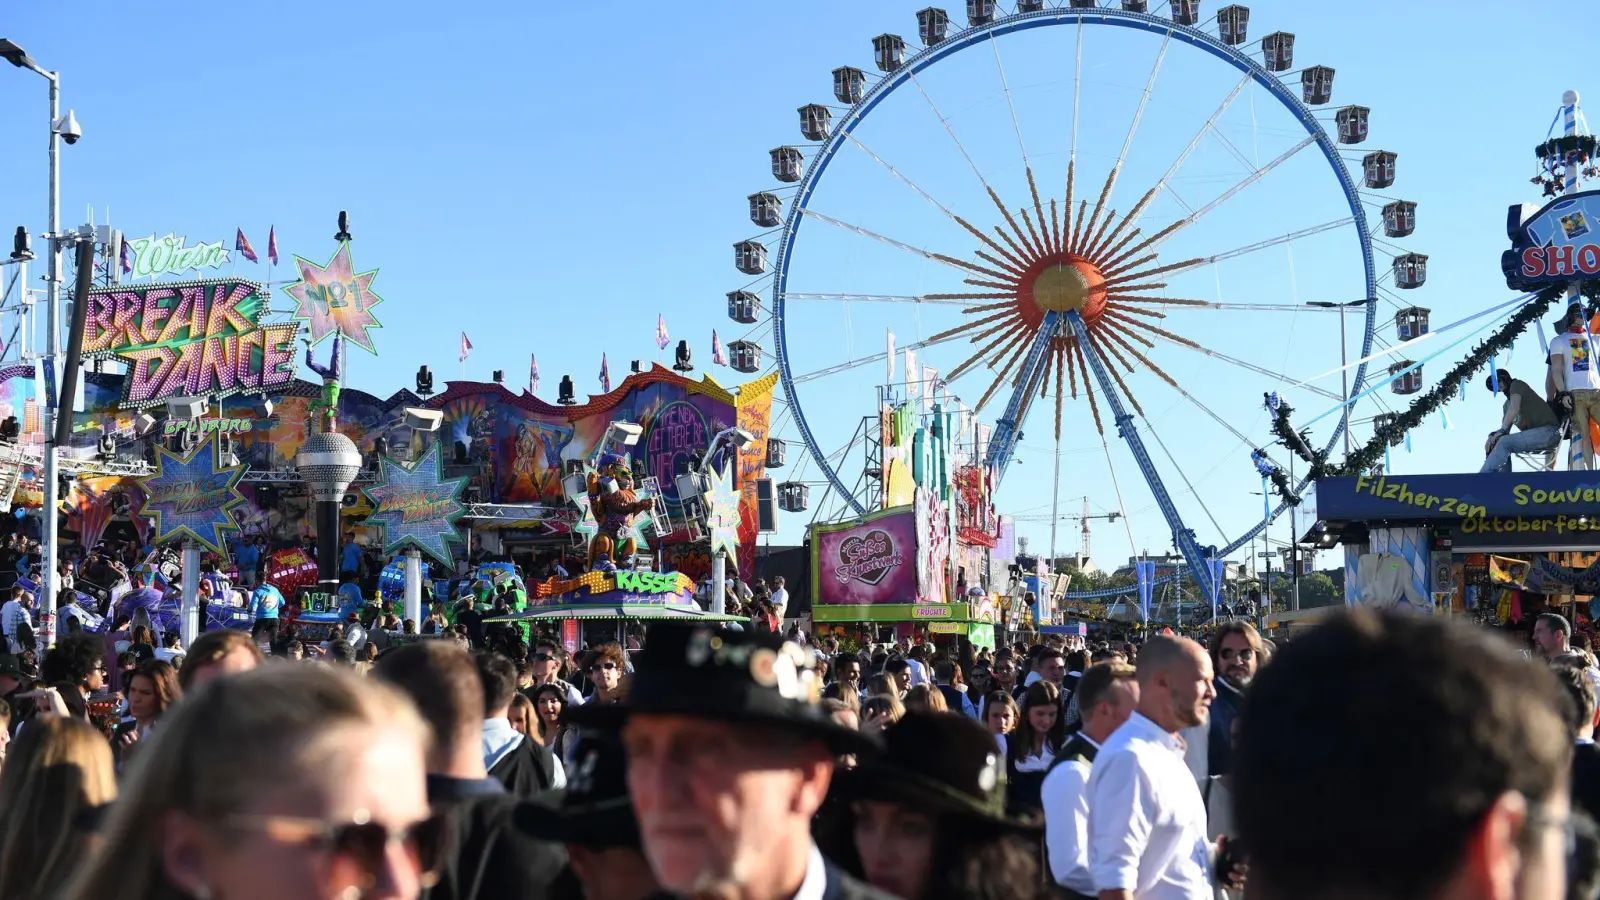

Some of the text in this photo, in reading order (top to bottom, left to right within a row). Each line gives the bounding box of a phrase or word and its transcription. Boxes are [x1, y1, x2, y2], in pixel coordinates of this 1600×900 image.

[134, 239, 224, 274] Wiesn
[81, 282, 257, 354] BREAK
[118, 326, 296, 402] DANCE
[1355, 476, 1486, 518] Filzherzen
[617, 570, 679, 594] KASSE
[916, 606, 947, 616] FRÜCHTE
